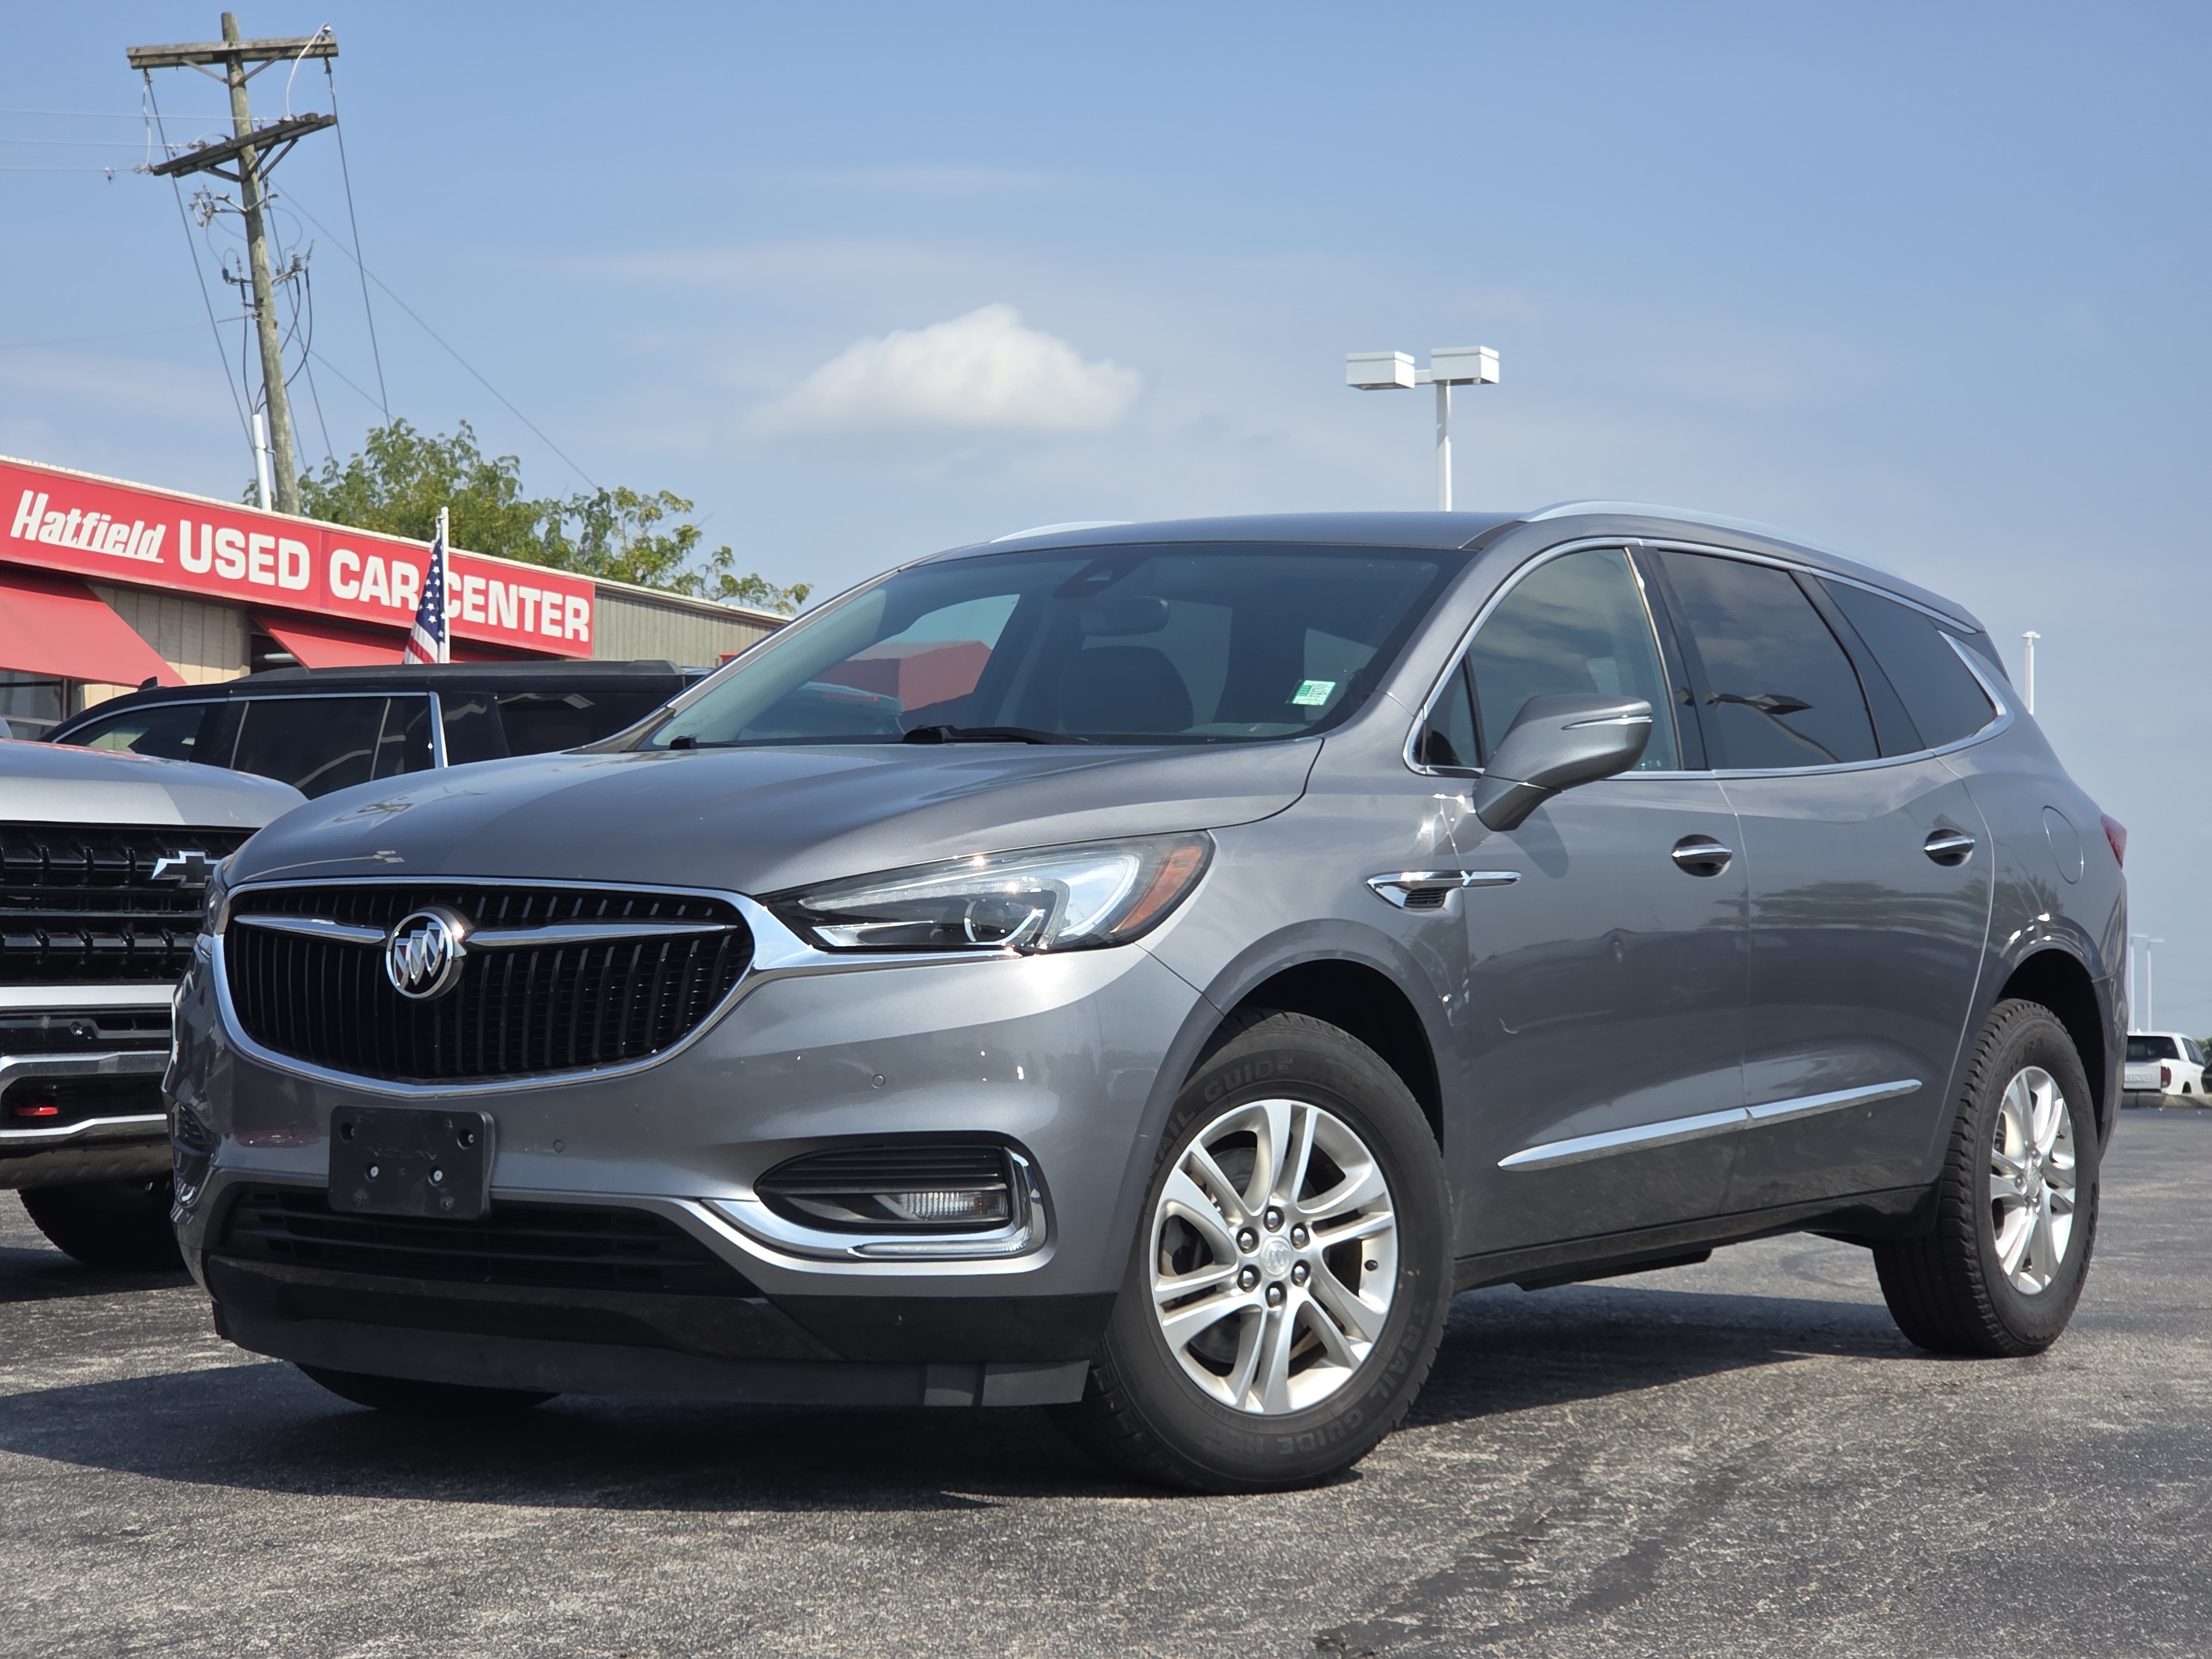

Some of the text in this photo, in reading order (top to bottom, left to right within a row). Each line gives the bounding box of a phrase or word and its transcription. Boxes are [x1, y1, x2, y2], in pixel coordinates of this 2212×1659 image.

[10, 489, 166, 564] Hatfield
[179, 519, 310, 591] USED
[329, 548, 419, 612] CAR
[1203, 1055, 1294, 1103] GUIDE
[1370, 1301, 1431, 1400] TRAIL
[1277, 1408, 1365, 1456] GUIDE
